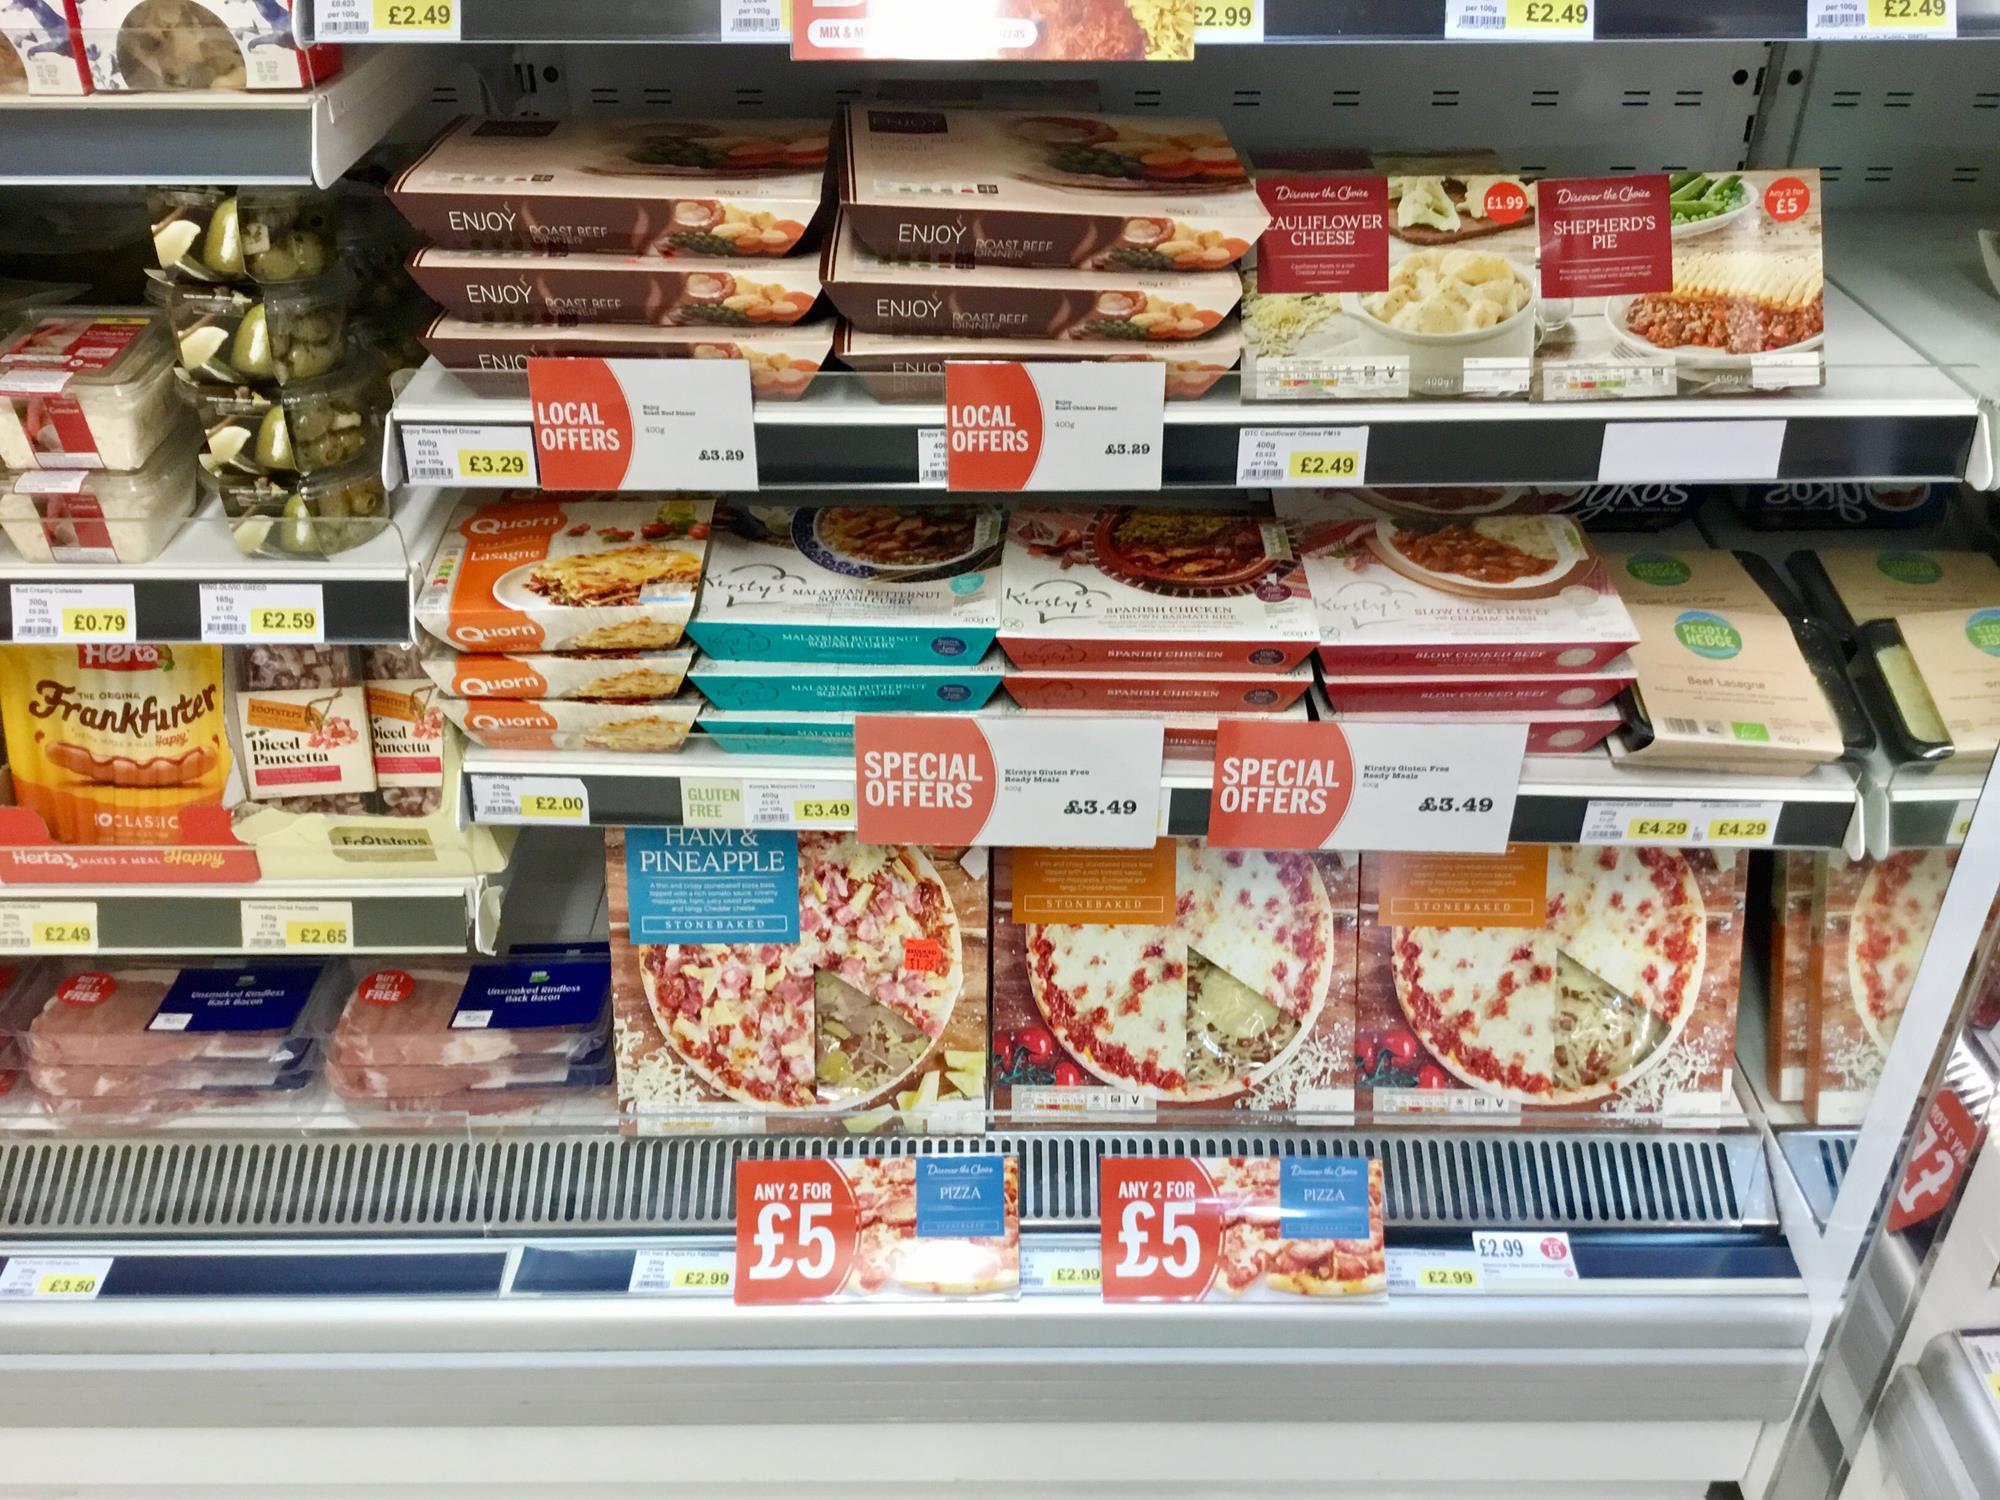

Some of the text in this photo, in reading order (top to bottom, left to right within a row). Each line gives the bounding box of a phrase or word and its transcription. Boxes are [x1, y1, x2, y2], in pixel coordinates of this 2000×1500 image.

[388, 5, 450, 25] £2.49
[1194, 6, 1251, 26] £2.99
[1526, 4, 1588, 24] £2.49
[1884, 0, 1945, 18] £2.49
[819, 26, 840, 39] MIX
[1275, 185, 1369, 201] Discover the Choice
[1556, 186, 1651, 205] Discover the Choice
[1487, 196, 1524, 209] £1.99
[1776, 199, 1799, 214] £5
[449, 210, 517, 232] ENJOY
[1553, 215, 1656, 236] SHEPHERD'S
[899, 223, 968, 245] ENJOY
[1290, 231, 1356, 247] CHEESE
[1592, 235, 1618, 250] PIE
[466, 283, 533, 304] ENJOY
[877, 298, 943, 319] ENJOY
[537, 402, 605, 426] LOCAL
[951, 405, 1016, 427] LOCAL
[541, 428, 621, 451] OFFERS
[951, 429, 1029, 453] OFFERS
[1256, 441, 1276, 450] 400g
[698, 449, 745, 461] £3.29
[1105, 443, 1151, 455] £3.29
[469, 456, 524, 473] £3.29
[1300, 456, 1354, 474] £2.49
[469, 513, 560, 535] Quorn
[471, 550, 540, 563] Lasagne
[1106, 605, 1233, 616] SPANISH CHICKEN
[1414, 607, 1454, 616] SLOW
[74, 614, 126, 631] £0.79
[262, 612, 315, 629] £2.59
[456, 623, 537, 643] Quorn
[1685, 633, 1735, 648] HEDGE
[1107, 650, 1224, 659] SPANISH CHICKEN
[1415, 650, 1453, 660] SLOW
[1456, 650, 1511, 660] COOKED
[460, 676, 539, 696] Quorn
[1687, 675, 1766, 690] Beef Lasagne
[78, 691, 142, 700] THE ORIGINAL
[1107, 689, 1220, 698] SPANISH CHICKEN
[28, 679, 216, 739] Frankfurter
[472, 713, 550, 731] Quorn
[155, 732, 188, 747] Happy
[251, 737, 300, 752] Diced
[253, 752, 329, 766] Pancetta
[863, 751, 984, 782] SPECIAL
[1038, 768, 1068, 777] Gluten
[1069, 768, 1090, 776] Free
[1221, 757, 1341, 789] SPECIAL
[1391, 772, 1419, 780] Meals
[1429, 765, 1450, 773] Free
[1034, 776, 1060, 784] Meals
[688, 787, 740, 801] GLUTEN
[865, 781, 973, 809] OFFERS
[1219, 786, 1328, 815] OFFERS
[536, 796, 584, 811] £2.00
[689, 803, 722, 818] FREE
[803, 803, 850, 817] £3.49
[1063, 799, 1138, 816] £3.49
[1418, 797, 1494, 813] £3.49
[1638, 821, 1767, 836] £4.29 £4.29
[664, 827, 760, 847] HAM &
[12, 850, 64, 866] Herta
[79, 857, 117, 865] MAKES
[130, 856, 160, 865] MEAL
[163, 850, 226, 868] Happy
[639, 850, 786, 873] PINEAPPLE
[1046, 900, 1143, 909] STONEBAKED
[1414, 902, 1512, 912] STONEBAKED
[665, 919, 766, 930] STONEBAKED
[45, 926, 91, 942] £2.49
[300, 928, 347, 943] £2.65
[63, 990, 101, 1002] FREE
[191, 989, 285, 999] Unsmoked Rindless
[365, 990, 401, 1002] FREE
[487, 984, 581, 996] Unsmoked Rindless
[207, 997, 264, 1006] Back Bacon
[505, 993, 561, 1003] Back Bacon
[926, 1163, 960, 1176] Discover
[1289, 1165, 1323, 1177] Discover
[754, 1182, 832, 1200] ANY 2 FOR
[939, 1186, 982, 1200] PIZZA
[1118, 1181, 1196, 1200] ANY 2 FOR
[1303, 1188, 1346, 1202] PIZZA
[749, 1202, 836, 1280] £5
[1115, 1201, 1202, 1279] £5
[1479, 1238, 1525, 1258] £2.99
[684, 1272, 730, 1285] £2.99
[1057, 1268, 1101, 1281] £2.99
[1428, 1271, 1474, 1285] £2.99
[48, 1279, 96, 1293] £3.50
